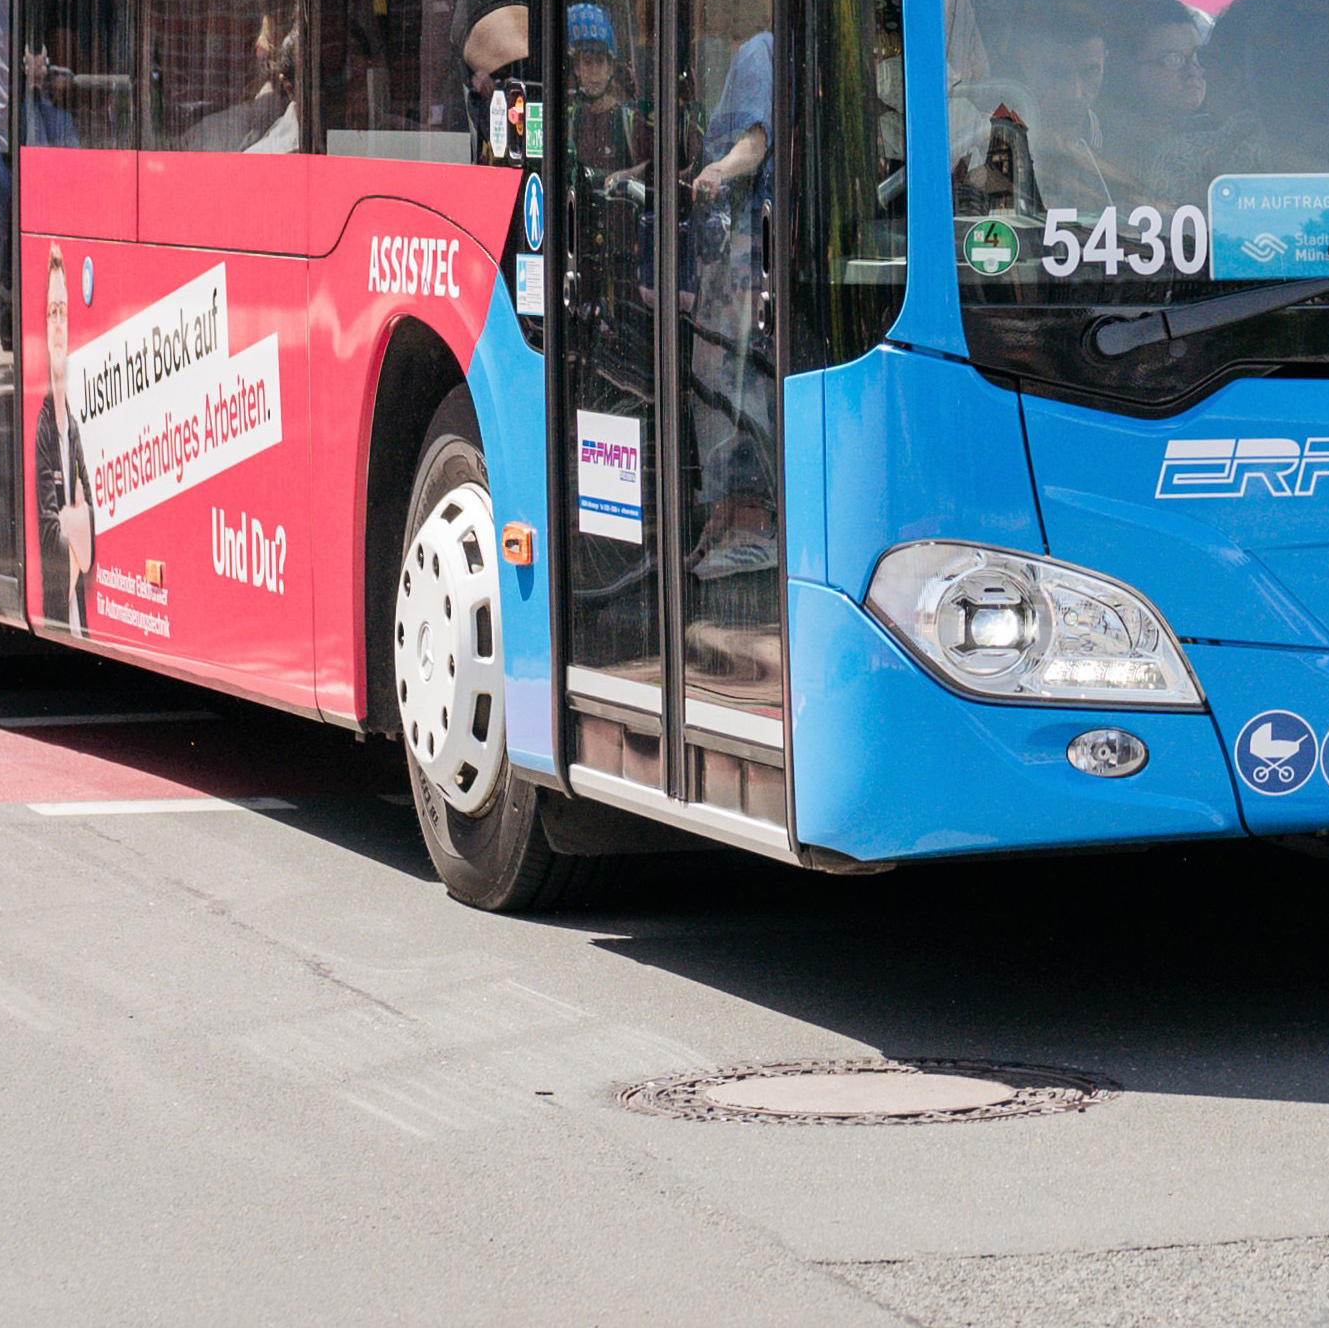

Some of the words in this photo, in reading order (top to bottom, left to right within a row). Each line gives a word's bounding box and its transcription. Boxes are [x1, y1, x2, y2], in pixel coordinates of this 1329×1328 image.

[984, 223, 999, 247] 4
[1237, 196, 1256, 210] IM
[368, 236, 460, 299] ASSISTEC
[1042, 204, 1208, 278] 5430
[81, 351, 123, 424] Justin
[125, 340, 149, 399] hat
[152, 308, 191, 383] Bock
[194, 287, 218, 360] auf
[94, 412, 199, 517] eigenständiges
[204, 374, 271, 453] Arbeiten.
[212, 506, 248, 584] Und
[251, 518, 287, 595] Du?
